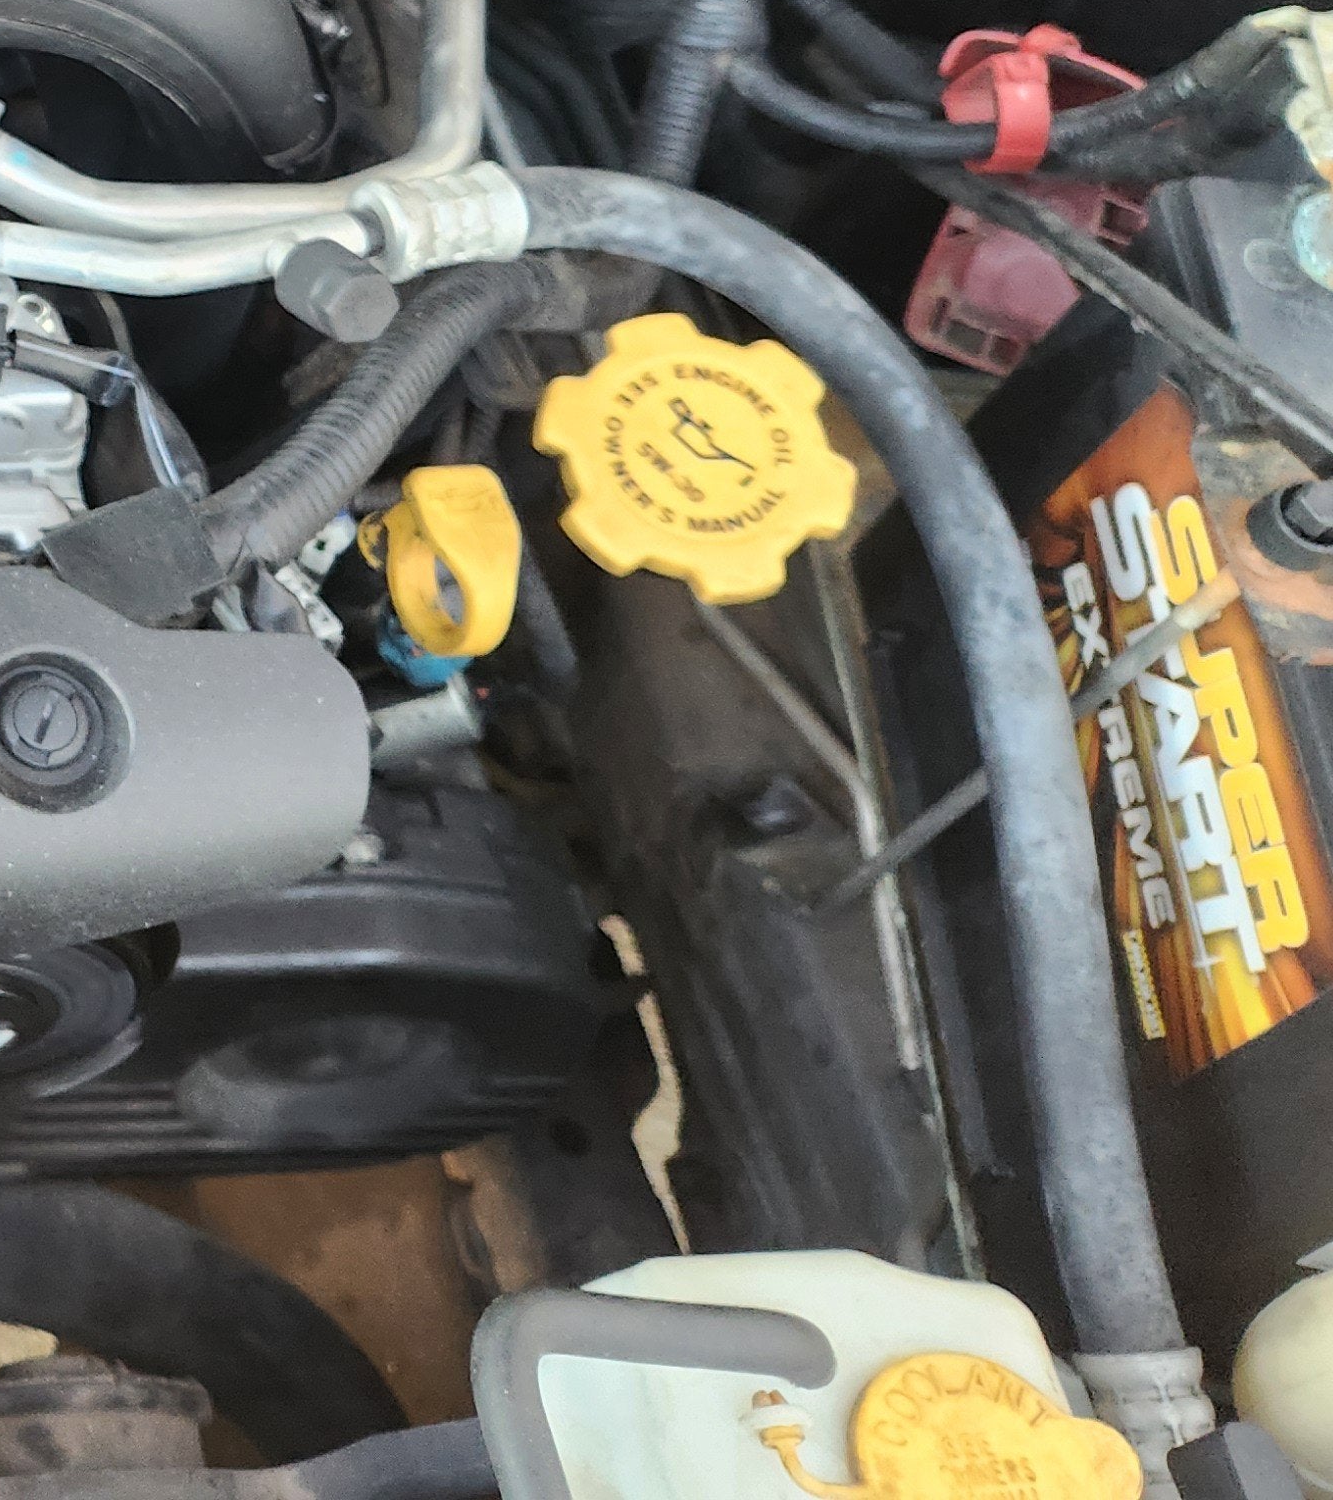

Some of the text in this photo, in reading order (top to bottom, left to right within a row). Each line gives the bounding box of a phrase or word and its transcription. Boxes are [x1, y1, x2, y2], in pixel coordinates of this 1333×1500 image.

[614, 371, 660, 409] SEE
[687, 488, 787, 533] MANUAL
[674, 363, 794, 467] ENGINE OIL
[1063, 561, 1176, 929] EXREME
[1089, 481, 1267, 973] START
[1149, 494, 1310, 954] SUPER
[873, 1362, 1053, 1448] COOLANT
